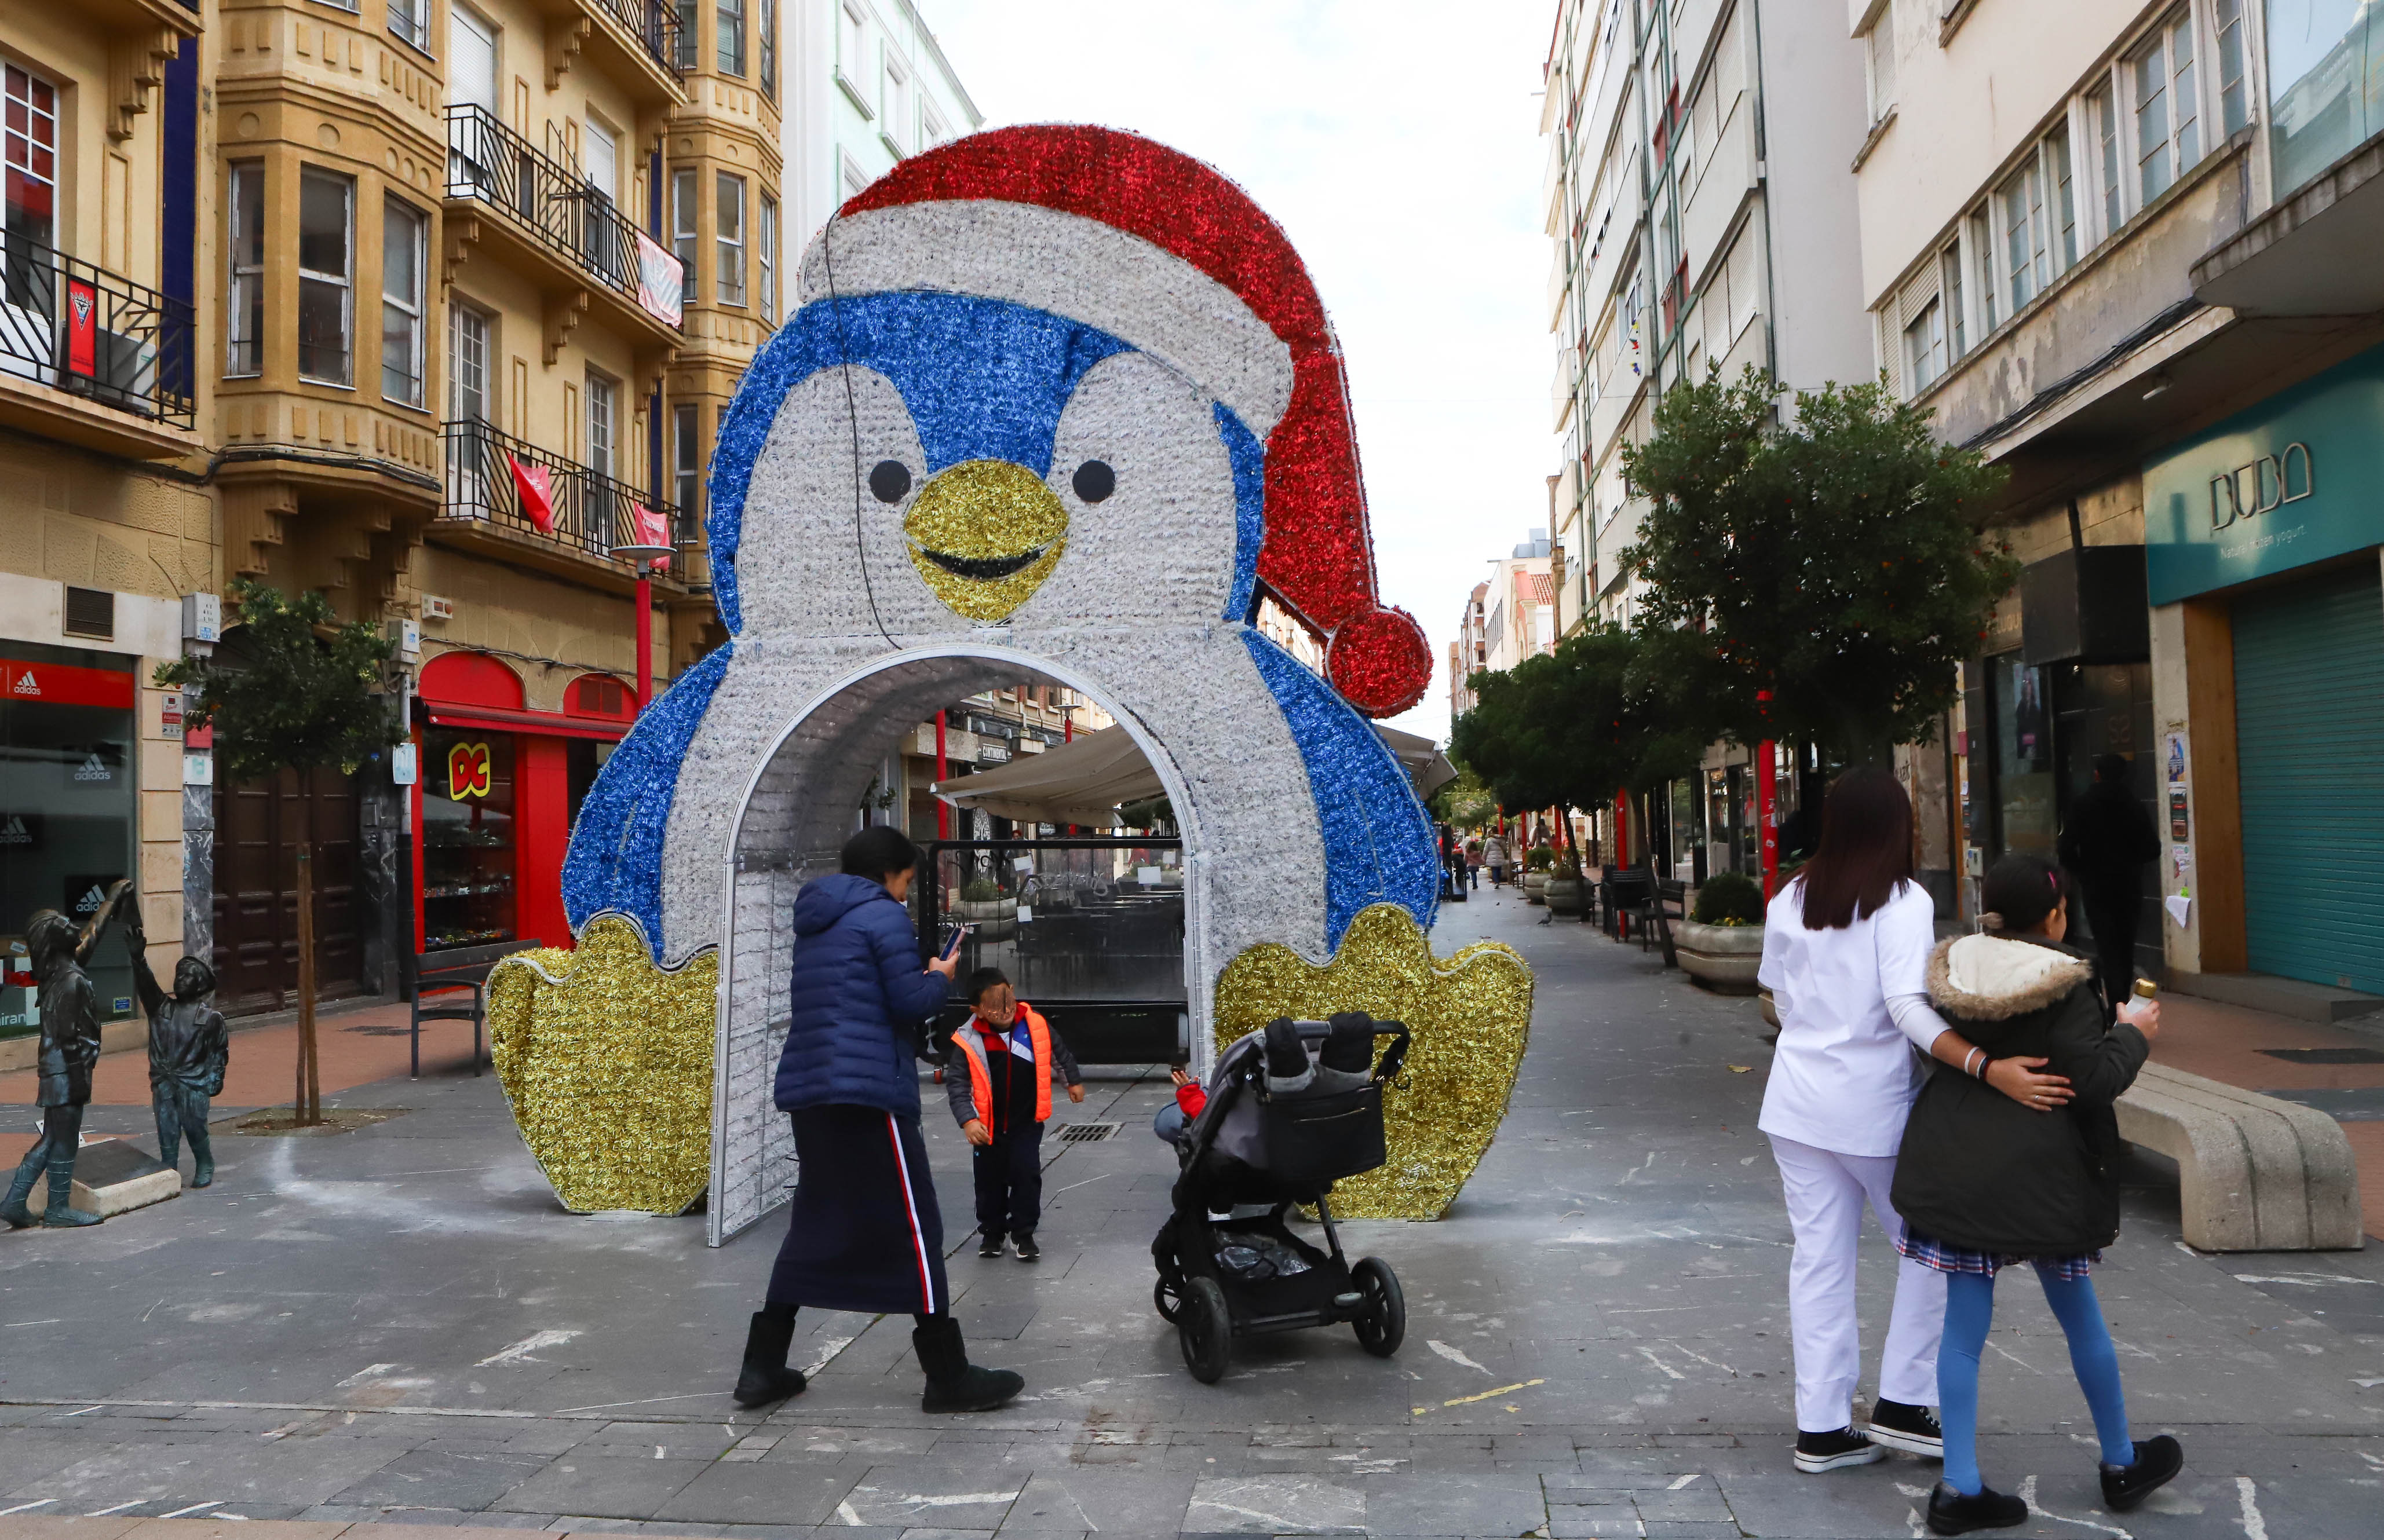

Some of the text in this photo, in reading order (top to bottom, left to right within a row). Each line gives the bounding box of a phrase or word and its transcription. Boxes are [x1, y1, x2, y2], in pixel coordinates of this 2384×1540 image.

[14, 685, 41, 695] adidas
[983, 745, 1007, 760] CONTINENTAL
[74, 770, 111, 780] adidas
[450, 745, 489, 798] DC
[0, 834, 32, 843] adidas
[76, 902, 100, 912] adid
[0, 1012, 26, 1026] iran
